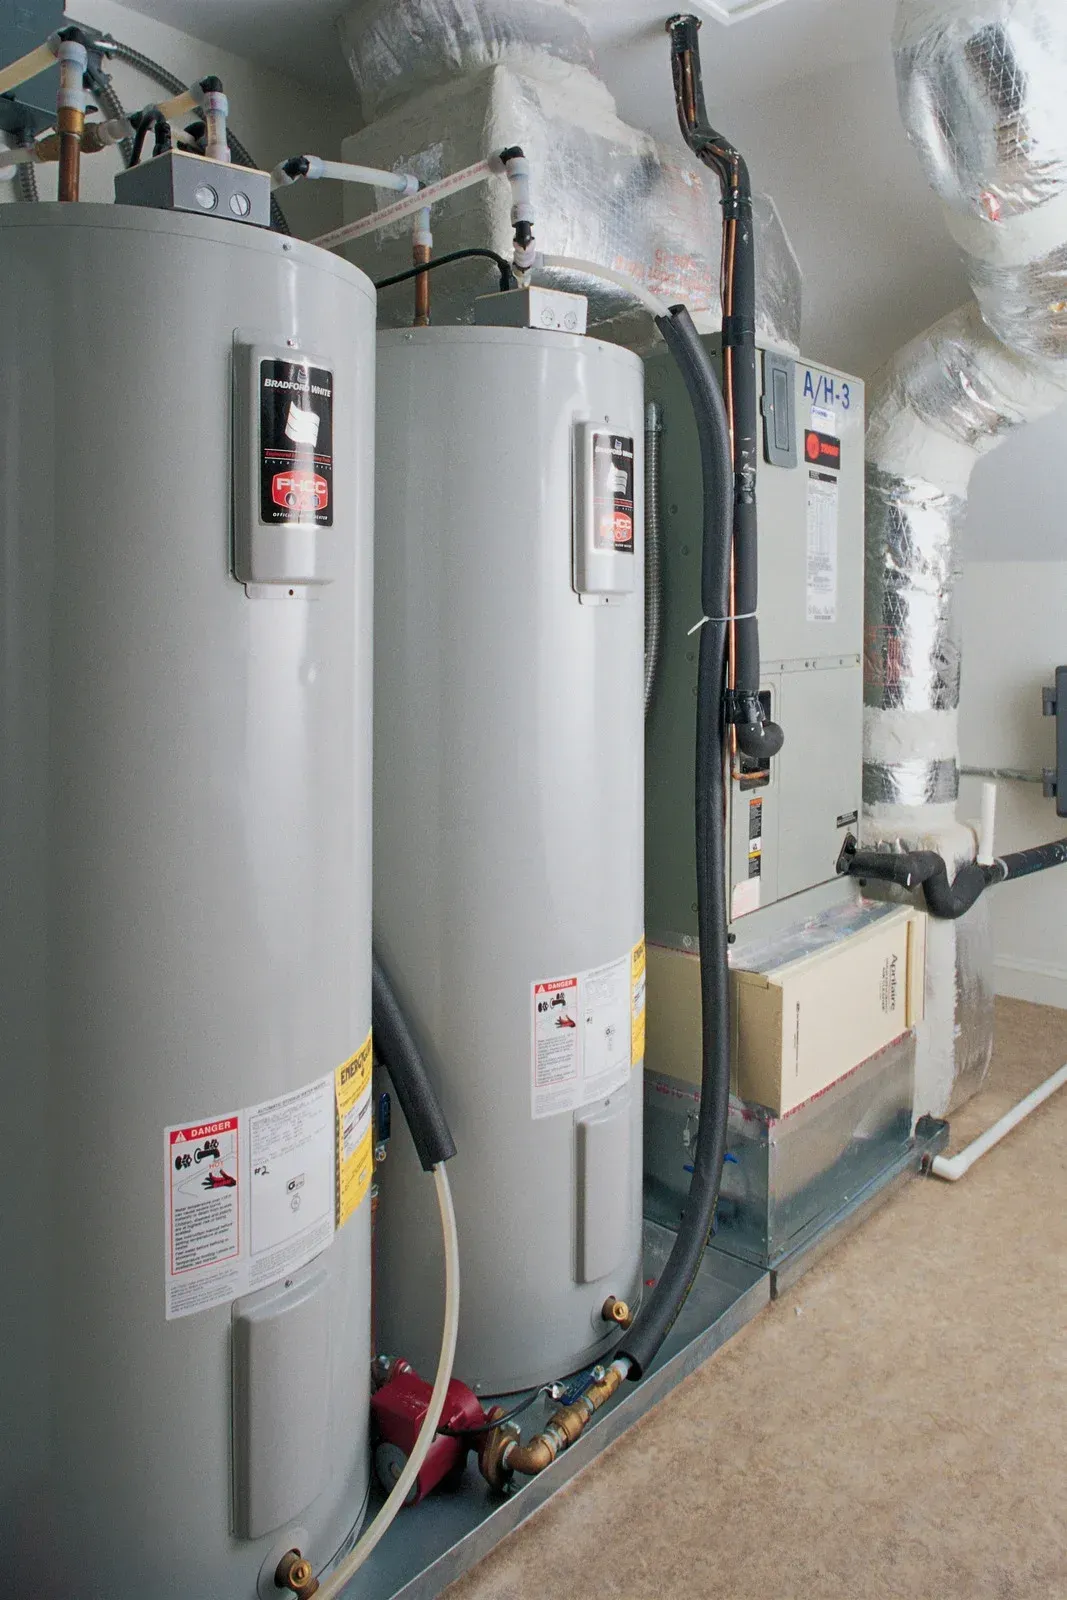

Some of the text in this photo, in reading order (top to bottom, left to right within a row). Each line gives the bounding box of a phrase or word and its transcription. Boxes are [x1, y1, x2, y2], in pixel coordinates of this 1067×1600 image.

[264, 378, 331, 398] BRADFORD WHITE
[804, 371, 849, 409] A/H-3
[276, 478, 326, 494] PHCC
[890, 954, 898, 1011] Aprilaire
[191, 1121, 231, 1138] DANGER
[208, 1161, 224, 1170] HOT
[254, 1166, 270, 1176] #2
